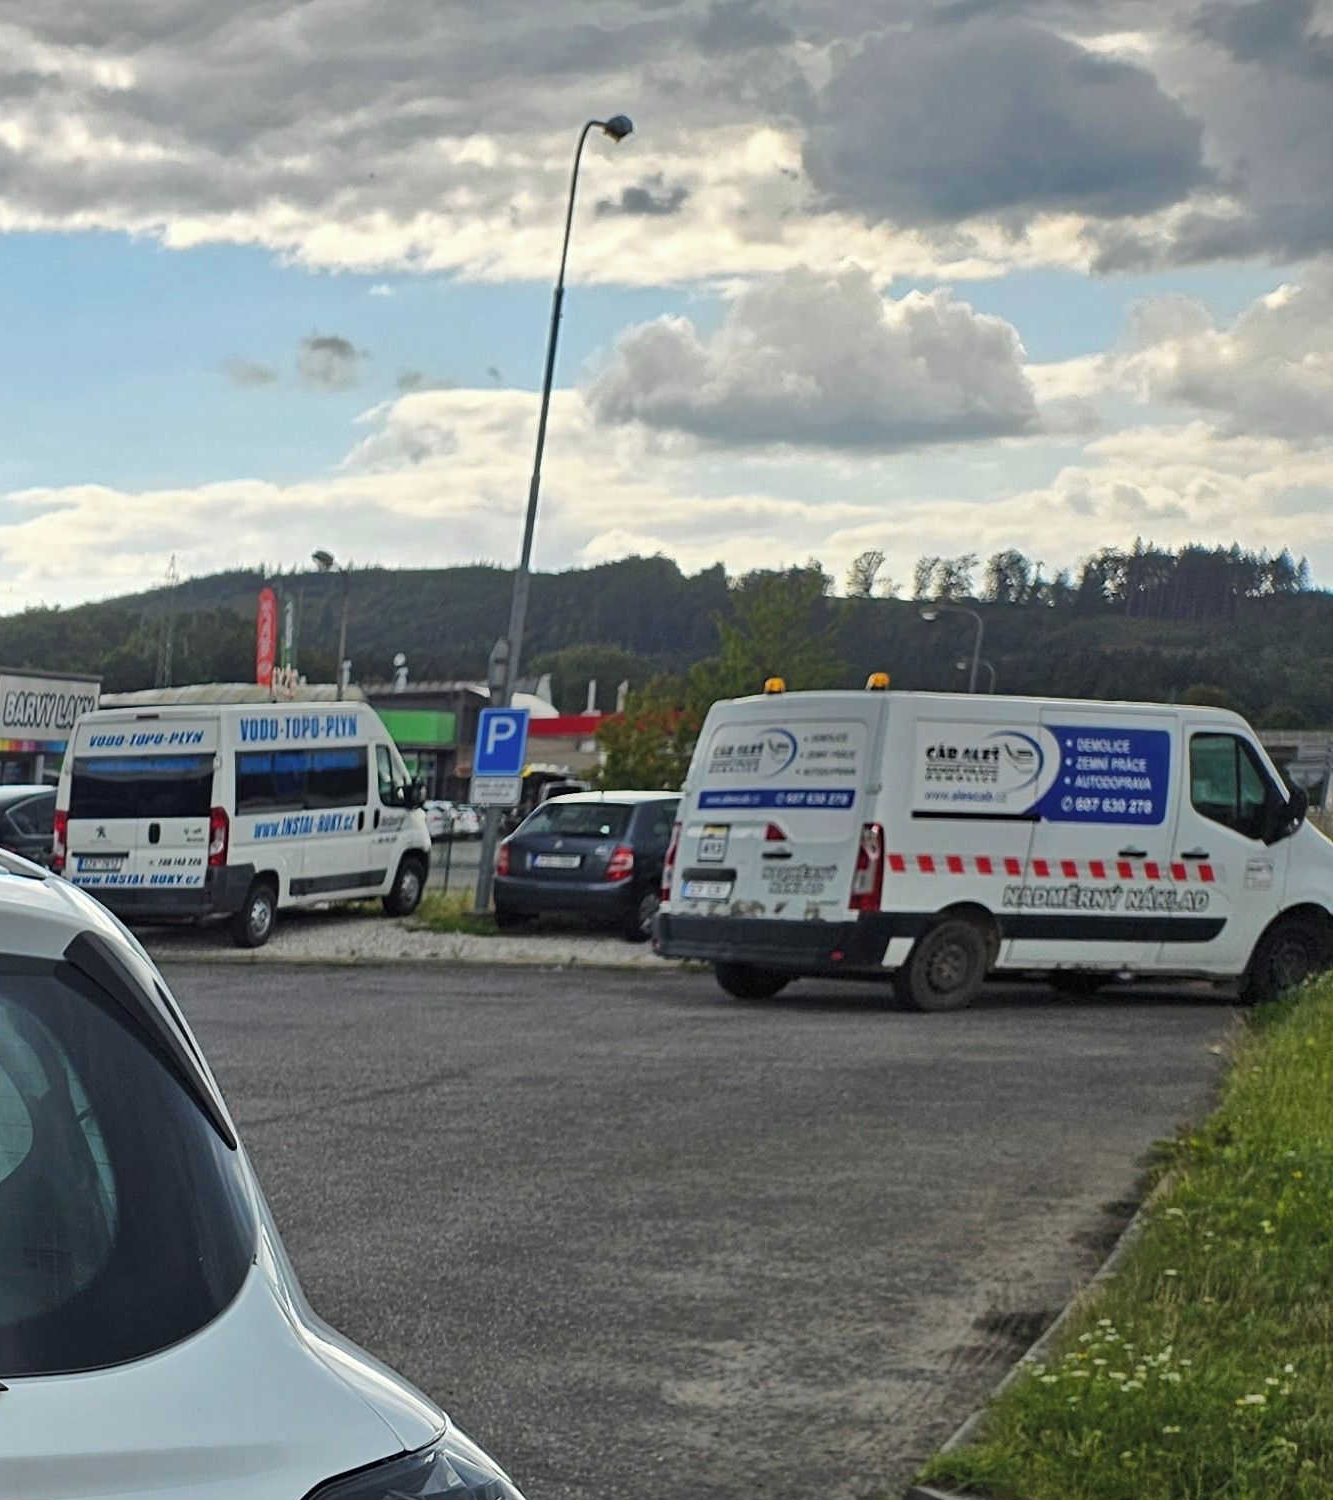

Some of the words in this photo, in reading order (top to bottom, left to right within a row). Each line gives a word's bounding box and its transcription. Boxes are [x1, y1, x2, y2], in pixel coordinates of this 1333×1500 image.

[3, 691, 57, 728] BARVY
[486, 716, 517, 755] P
[1002, 883, 1122, 910] NADMĚRNÝ
[1124, 886, 1210, 912] NÁKLAD
